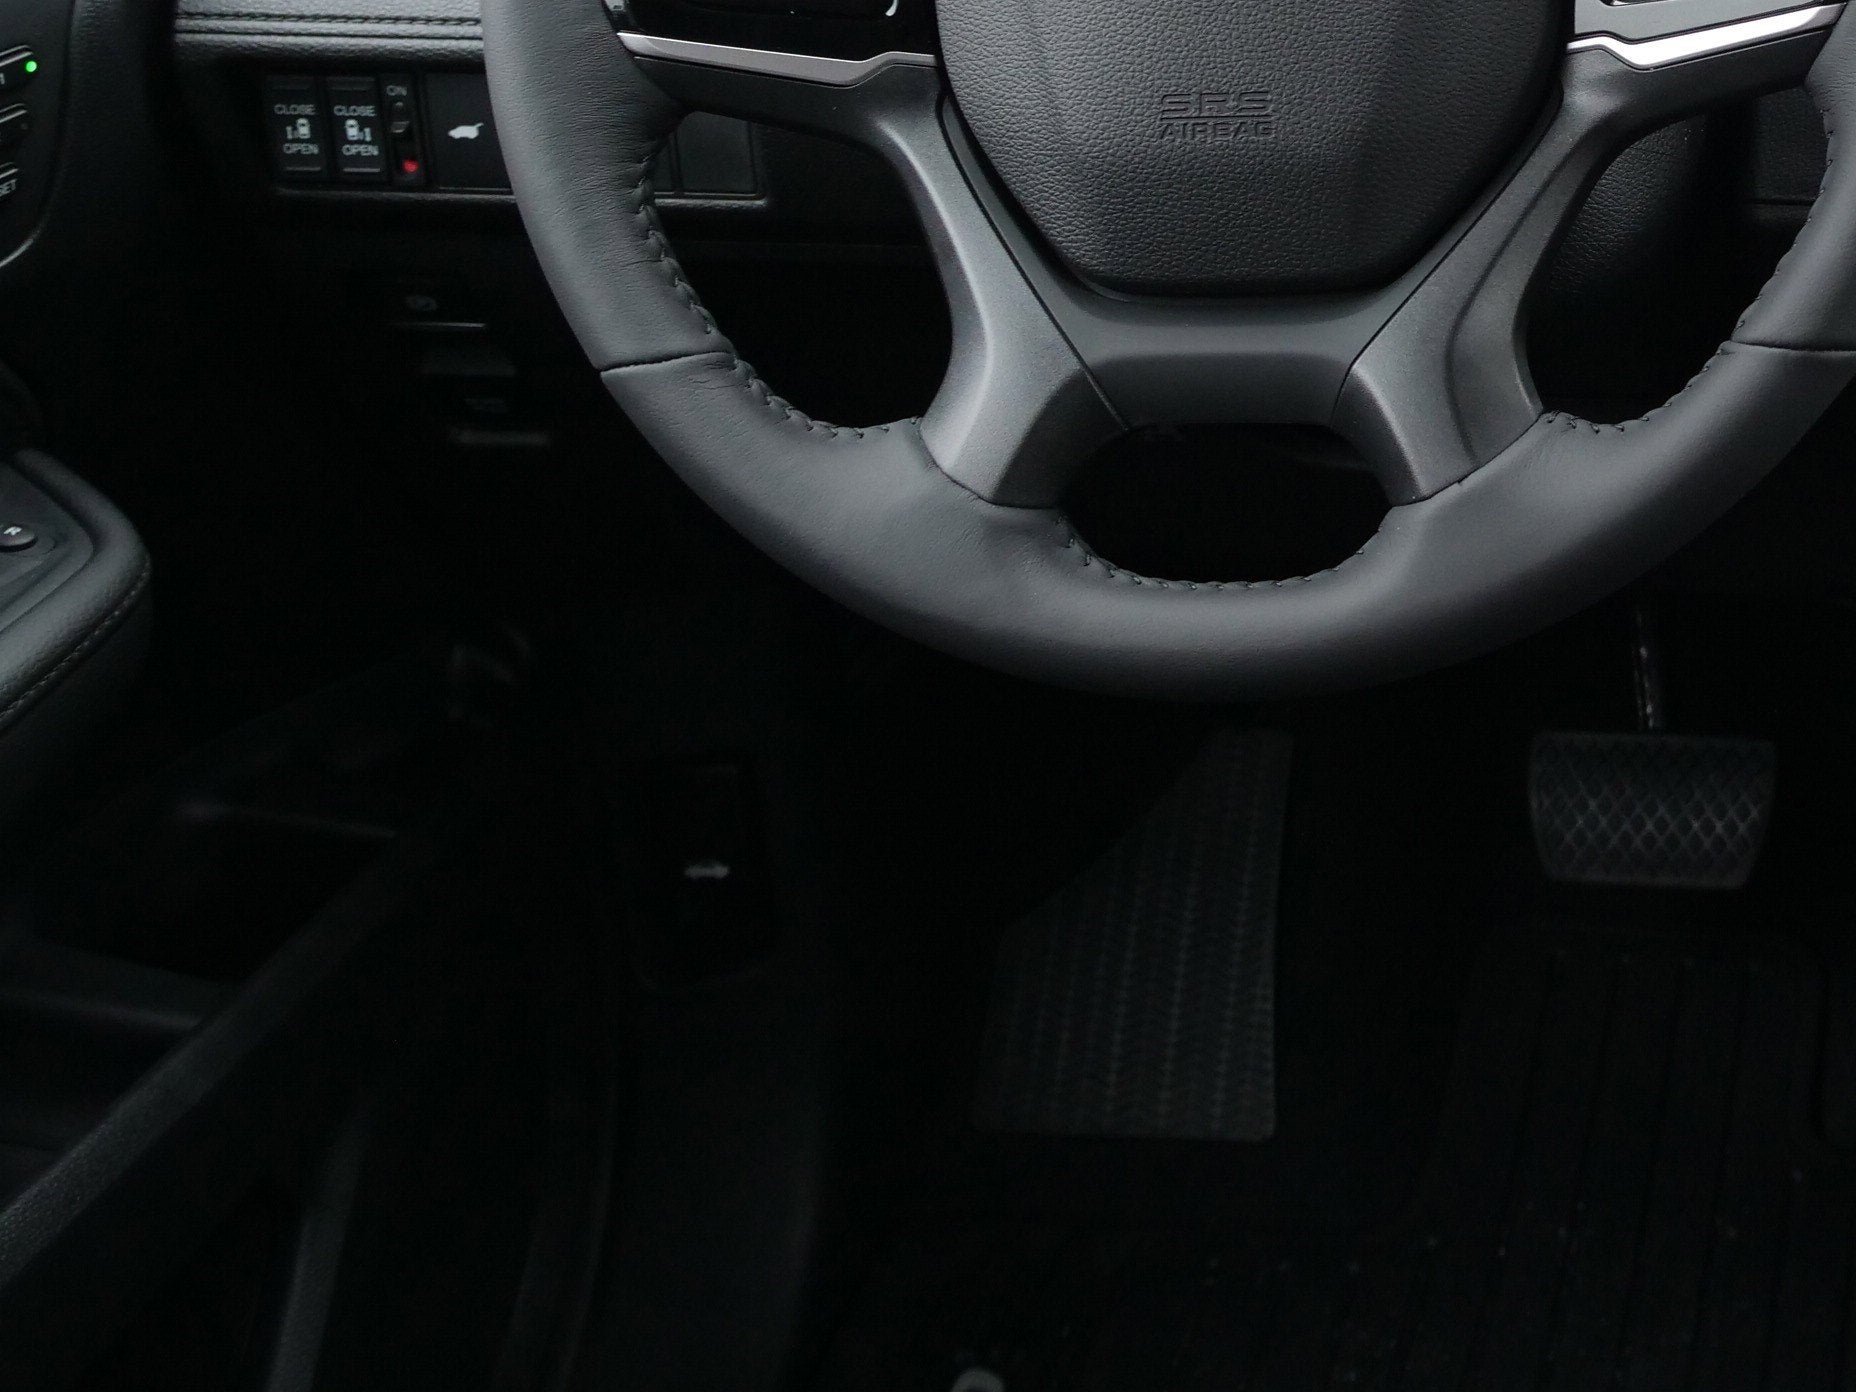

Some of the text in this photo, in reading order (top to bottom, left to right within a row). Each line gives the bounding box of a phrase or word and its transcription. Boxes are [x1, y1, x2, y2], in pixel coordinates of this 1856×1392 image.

[386, 85, 407, 96] ON
[1161, 91, 1273, 114] SRS
[274, 104, 316, 116] CLOSE
[333, 105, 376, 117] CLOSE
[1159, 121, 1277, 141] AIRBAG
[283, 143, 319, 154] OPEN
[342, 144, 379, 156] OPEN
